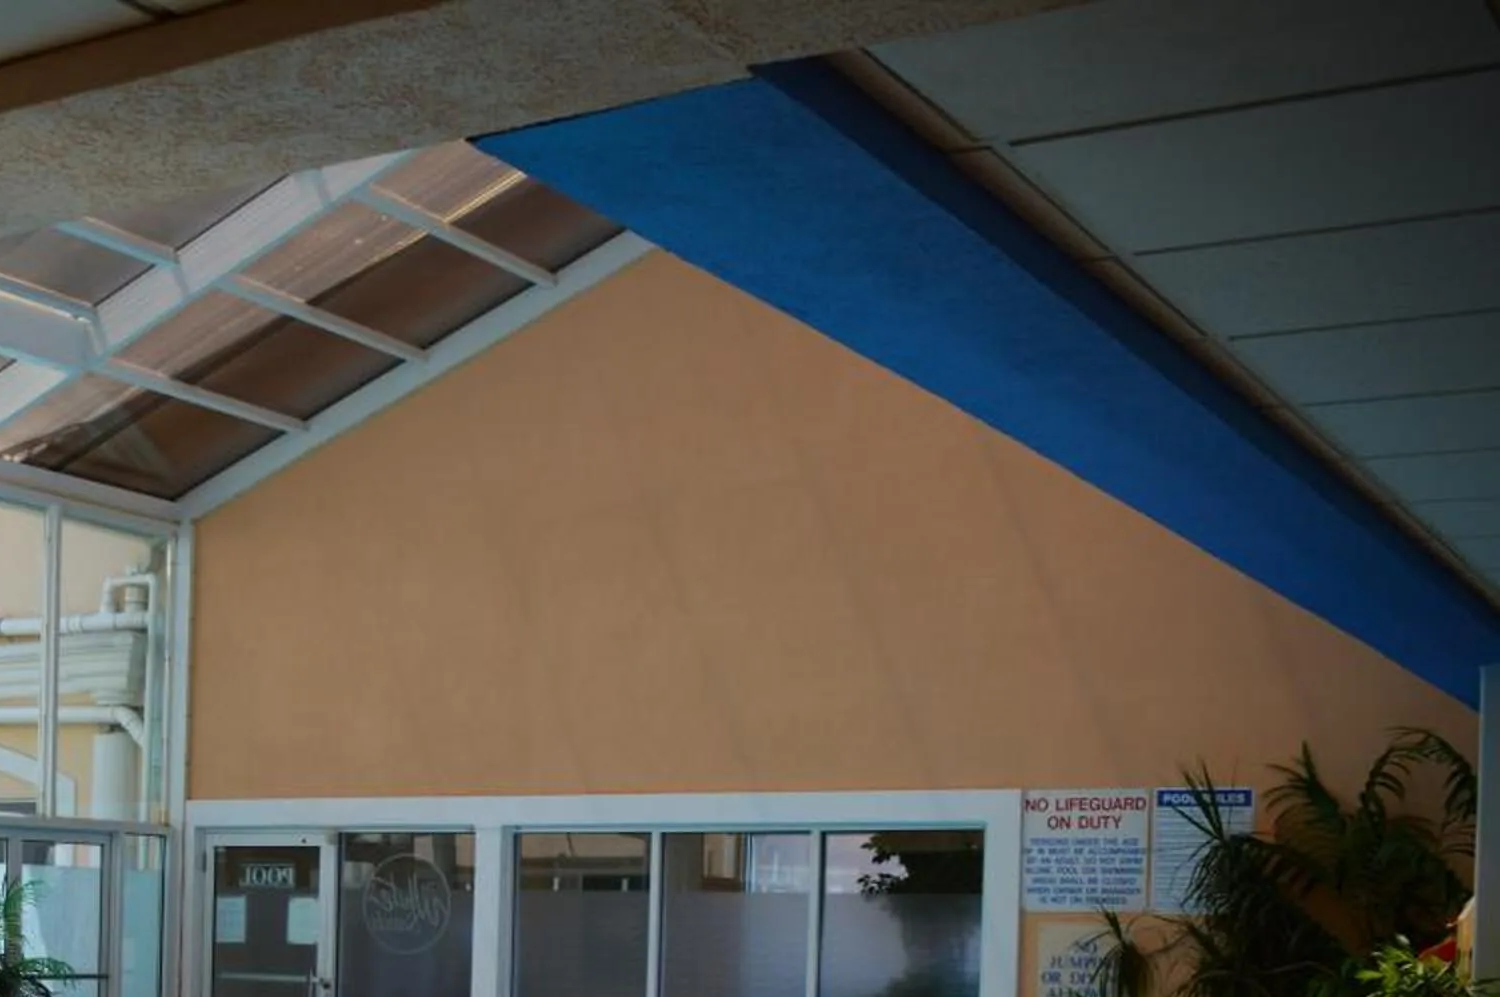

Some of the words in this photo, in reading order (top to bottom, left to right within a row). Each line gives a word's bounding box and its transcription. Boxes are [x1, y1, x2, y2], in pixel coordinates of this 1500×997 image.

[1025, 798, 1049, 812] NO
[1055, 797, 1147, 812] LIFEGUARD
[1047, 816, 1071, 830] ON
[1078, 815, 1122, 830] DUTY
